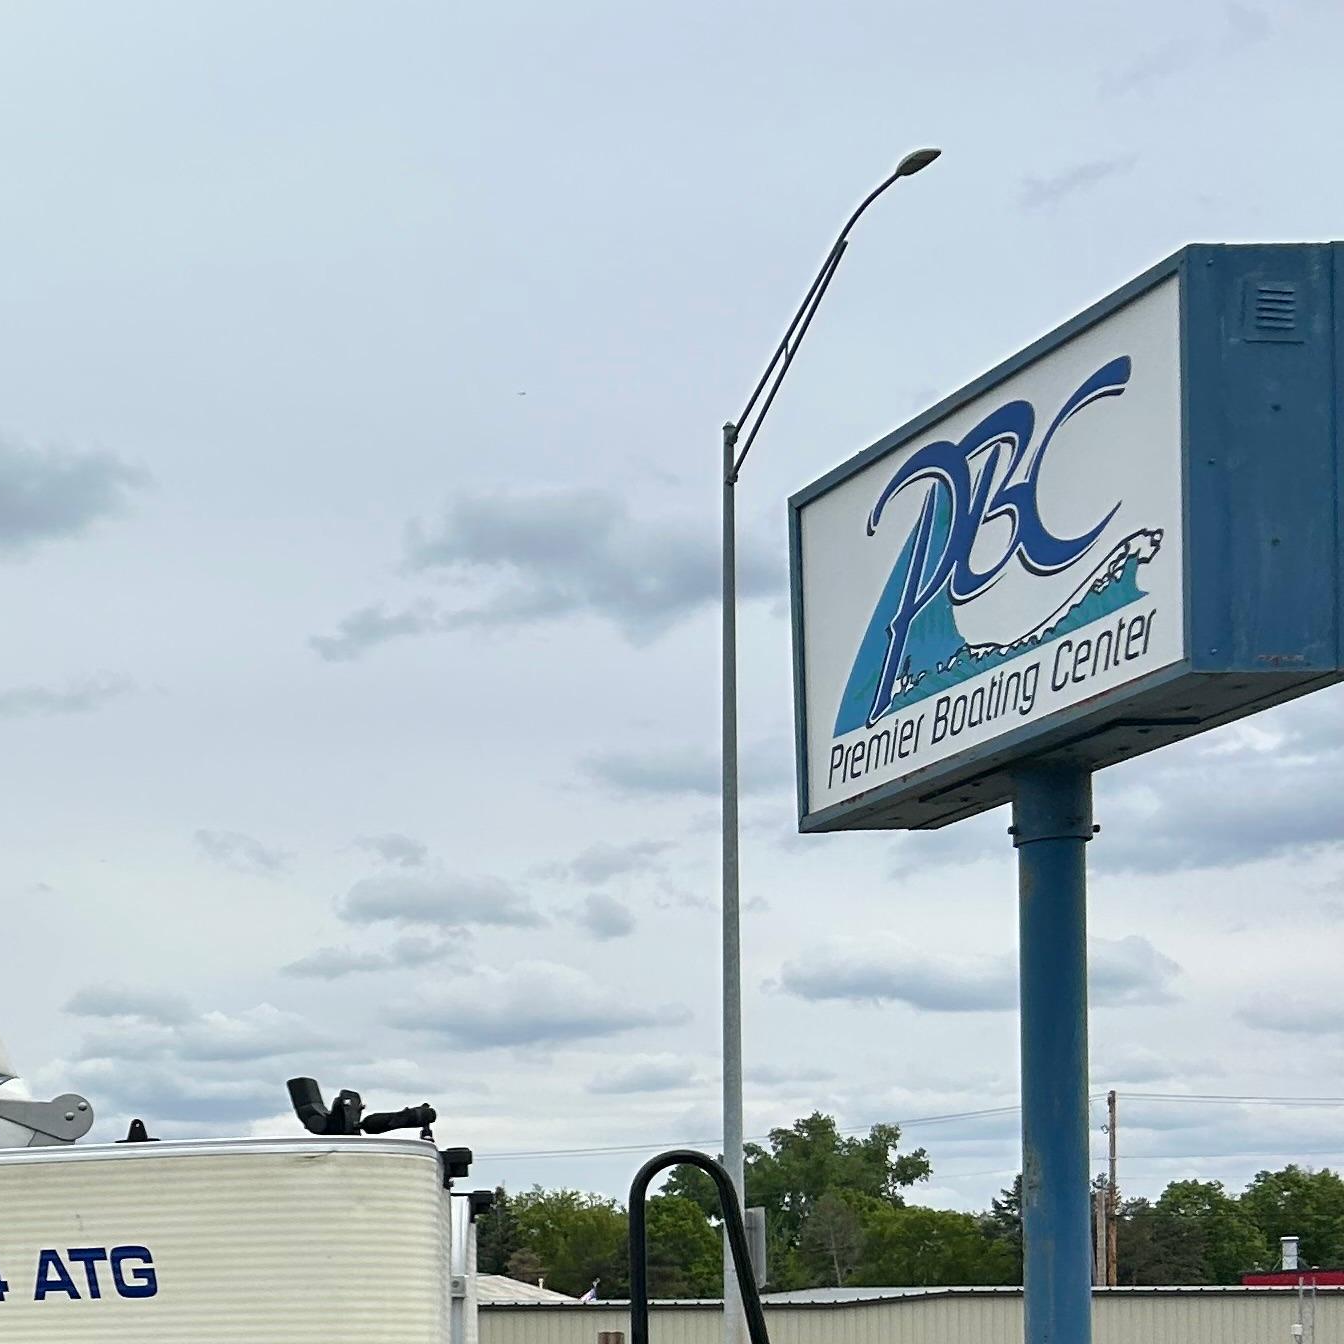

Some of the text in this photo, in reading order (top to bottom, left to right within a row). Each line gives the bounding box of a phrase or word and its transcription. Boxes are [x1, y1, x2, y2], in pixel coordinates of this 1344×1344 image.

[866, 354, 1132, 729] PBC
[826, 608, 1157, 790] Premier Boating Center
[33, 1244, 159, 1302] ATG
